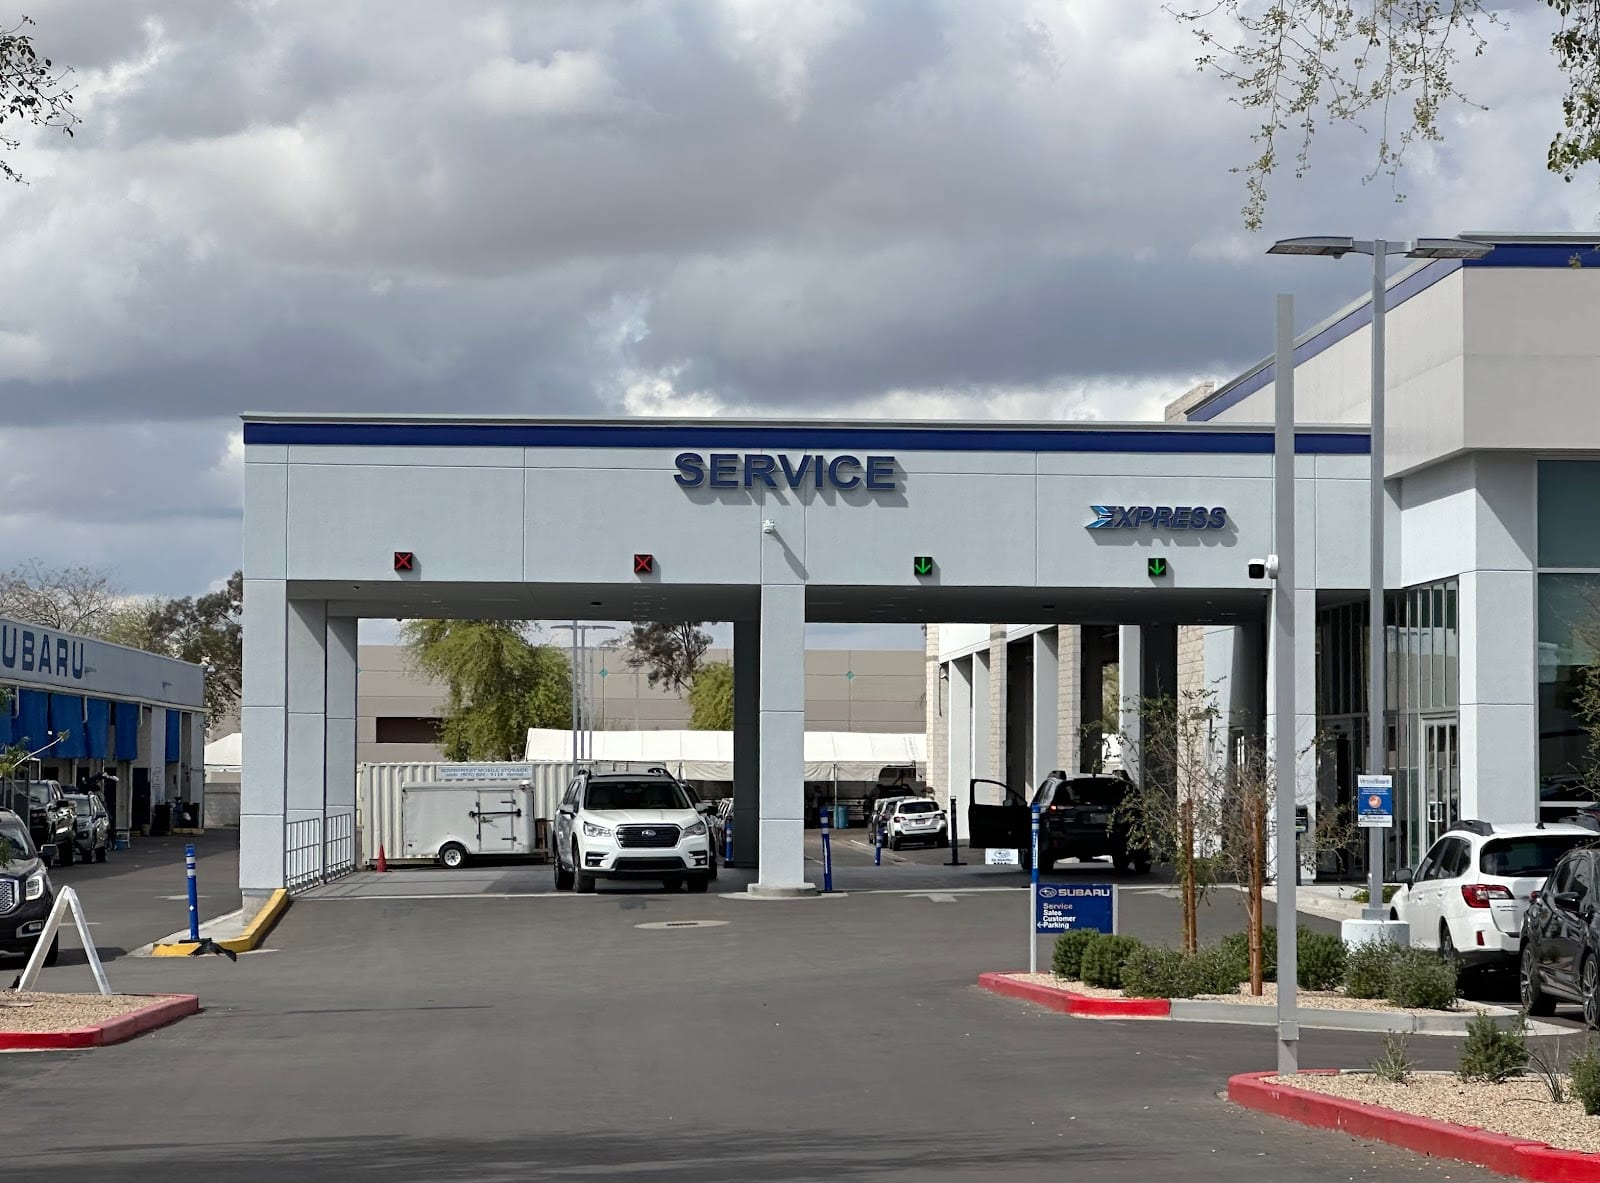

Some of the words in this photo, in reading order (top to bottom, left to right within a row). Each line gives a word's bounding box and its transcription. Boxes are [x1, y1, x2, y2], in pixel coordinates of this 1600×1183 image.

[673, 452, 896, 490] SERVICE
[1085, 505, 1227, 529] EXPRESS
[1058, 888, 1110, 897] SUBARU
